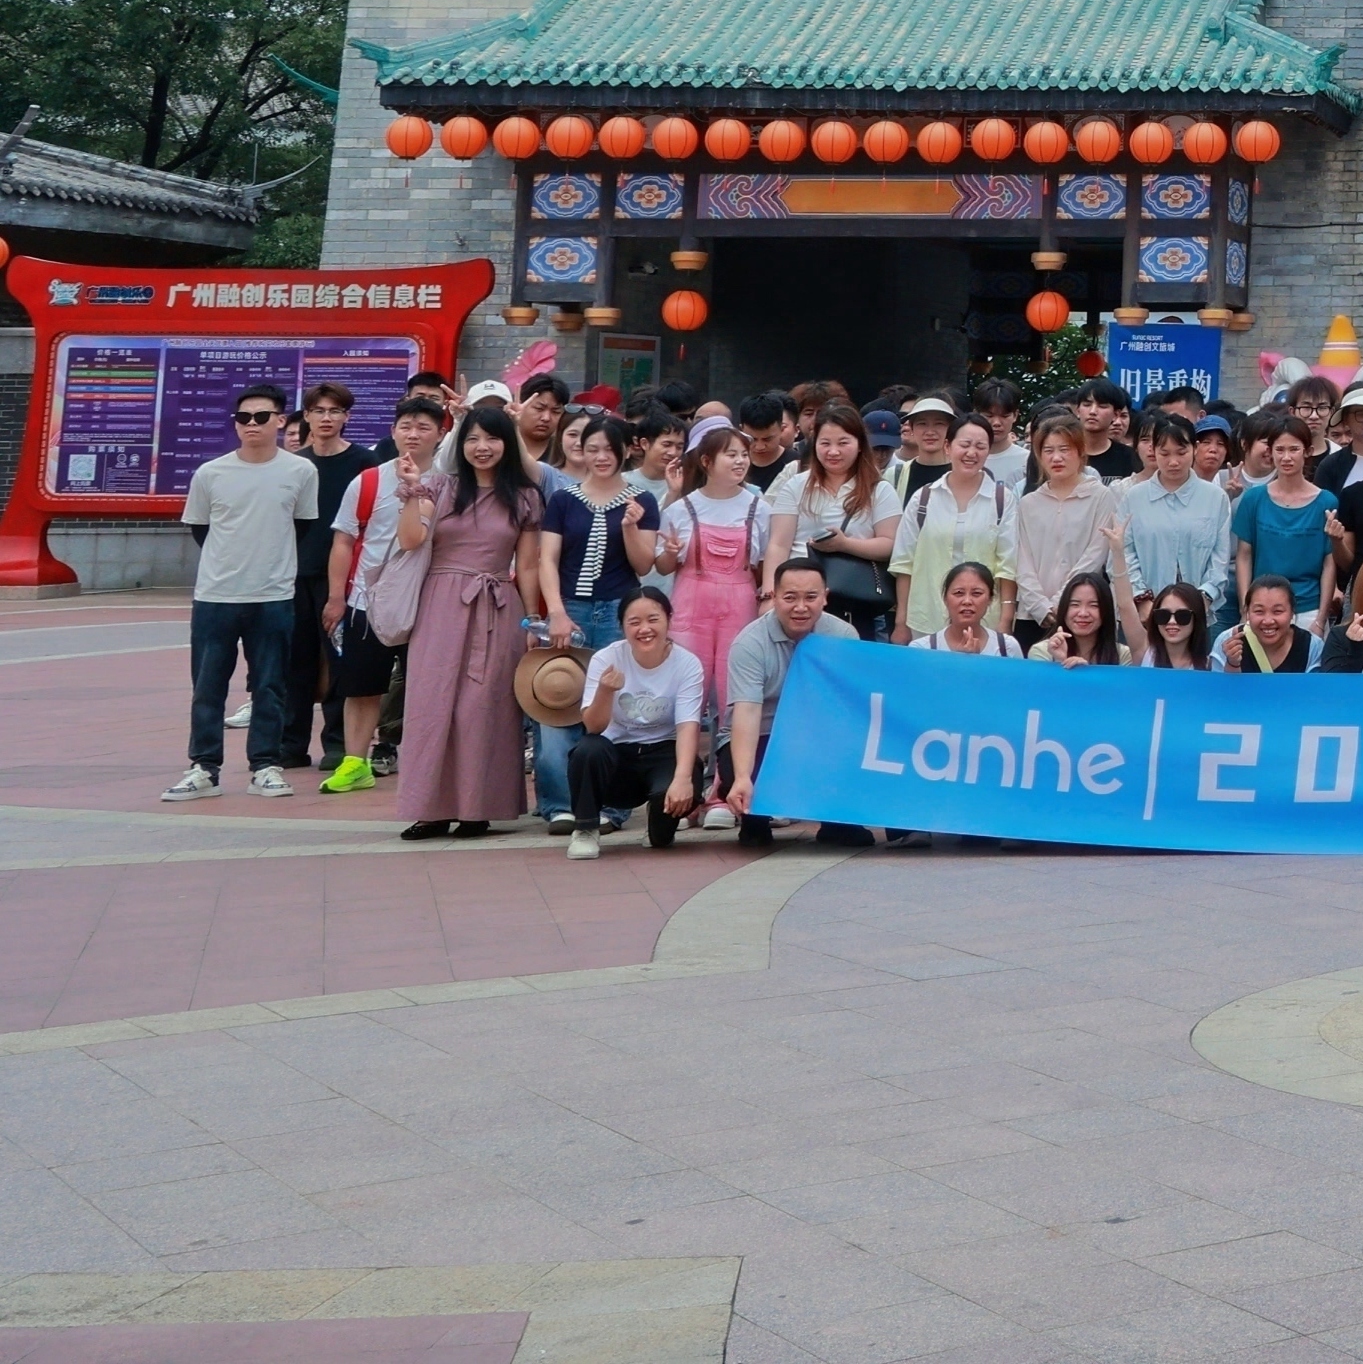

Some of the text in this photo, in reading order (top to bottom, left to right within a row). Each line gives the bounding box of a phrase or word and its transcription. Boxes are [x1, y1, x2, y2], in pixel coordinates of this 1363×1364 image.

[166, 283, 442, 310] 广州融创乐园综合信息栏
[859, 691, 1127, 797] Lanhe
